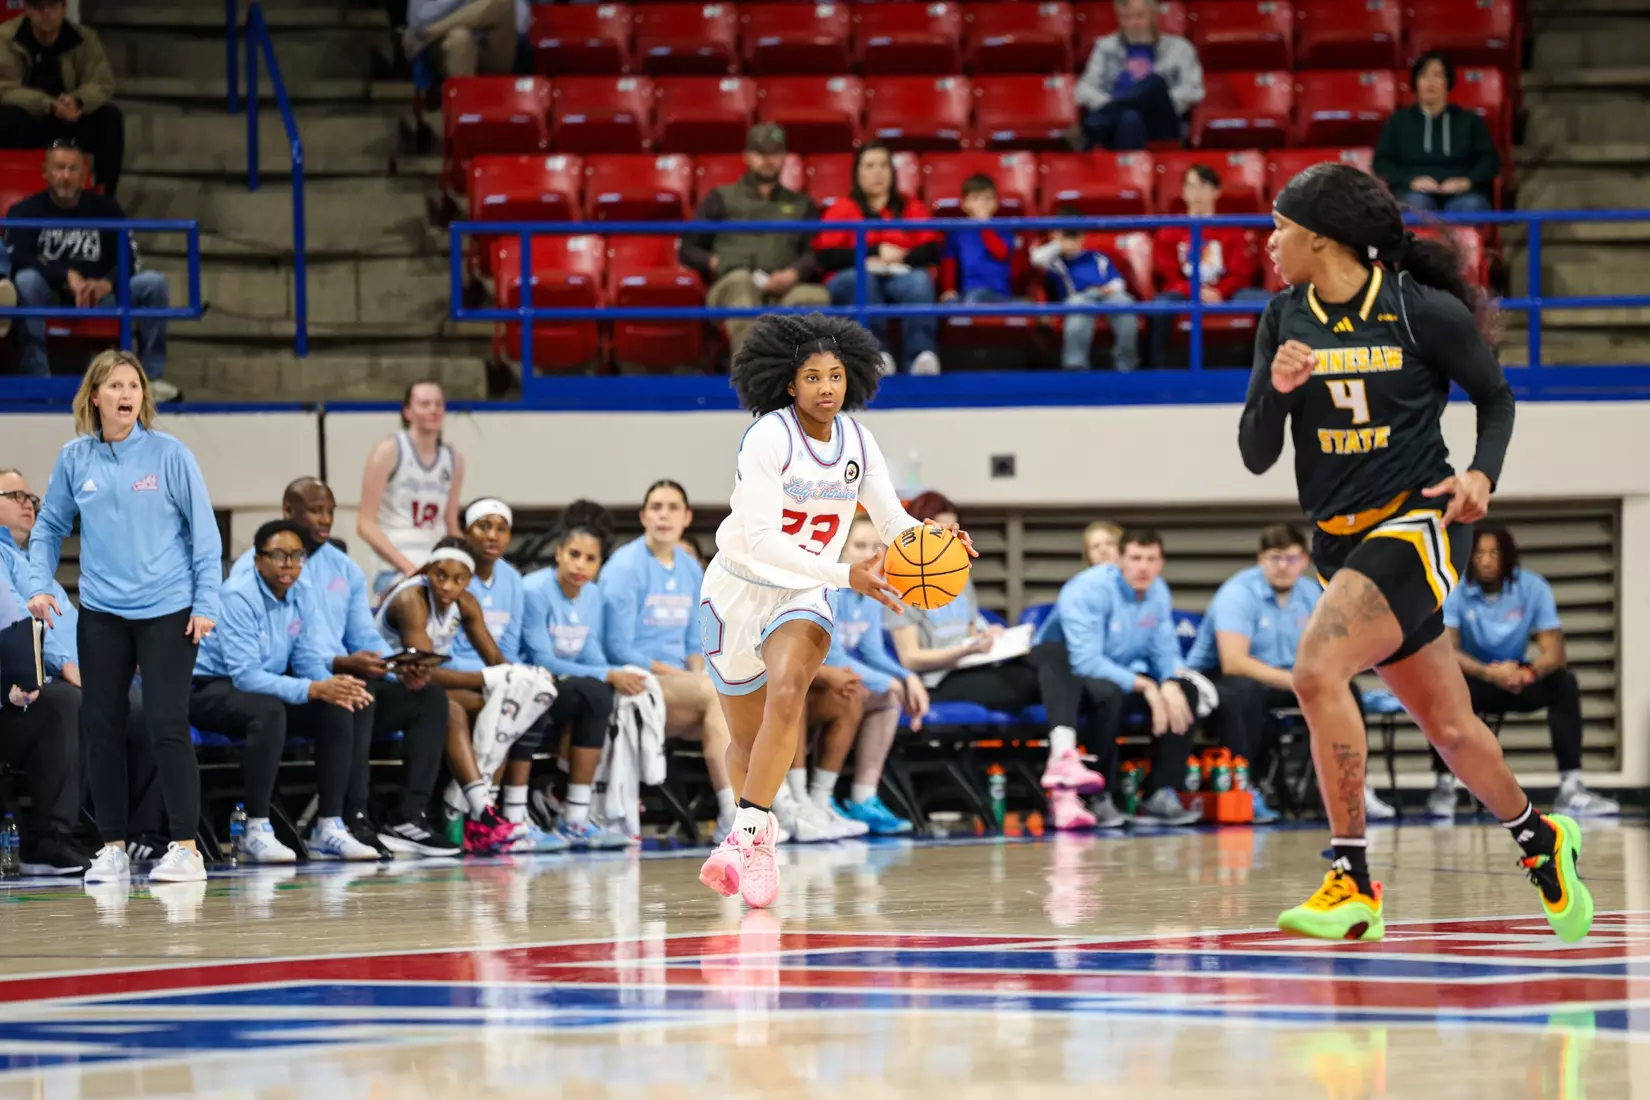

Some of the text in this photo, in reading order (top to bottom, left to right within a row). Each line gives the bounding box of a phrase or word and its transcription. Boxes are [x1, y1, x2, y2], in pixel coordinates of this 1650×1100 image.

[1311, 346, 1403, 375] NNESAW
[1324, 378, 1371, 425] 4
[1317, 425, 1391, 455] STATE
[783, 476, 815, 504] Lady
[781, 508, 840, 555] 23
